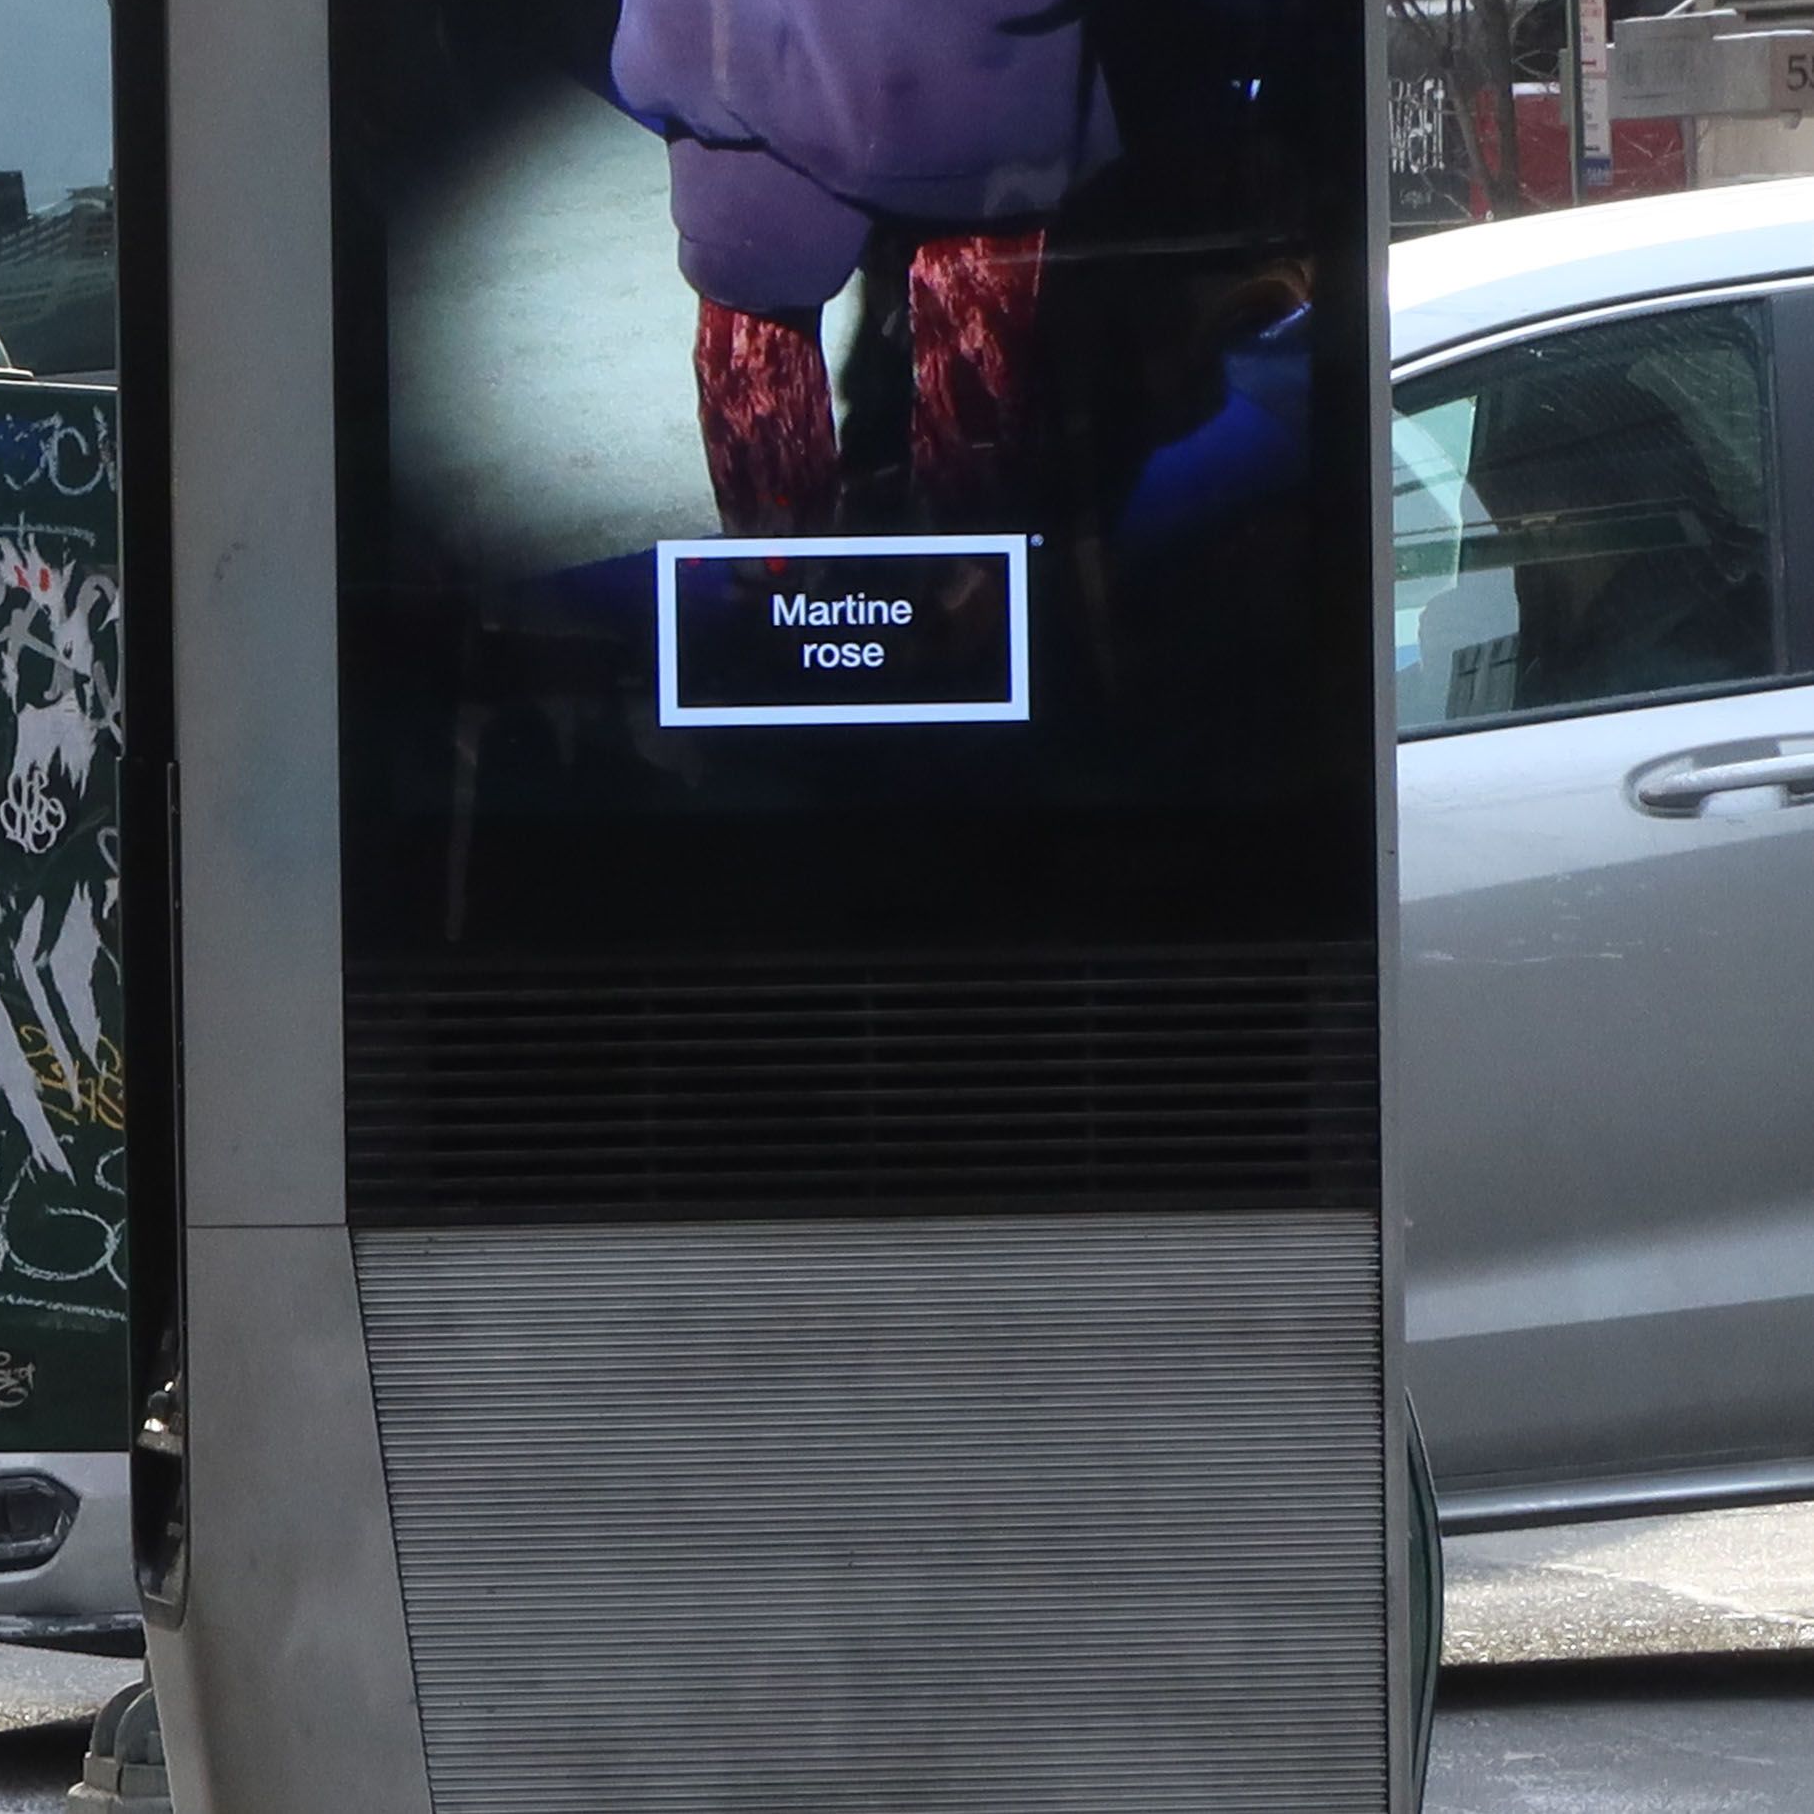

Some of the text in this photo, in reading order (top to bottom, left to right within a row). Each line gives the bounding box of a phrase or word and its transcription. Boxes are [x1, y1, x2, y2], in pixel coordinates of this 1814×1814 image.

[1787, 54, 1814, 93] 5
[772, 593, 913, 627] Martine
[802, 641, 884, 668] rose
